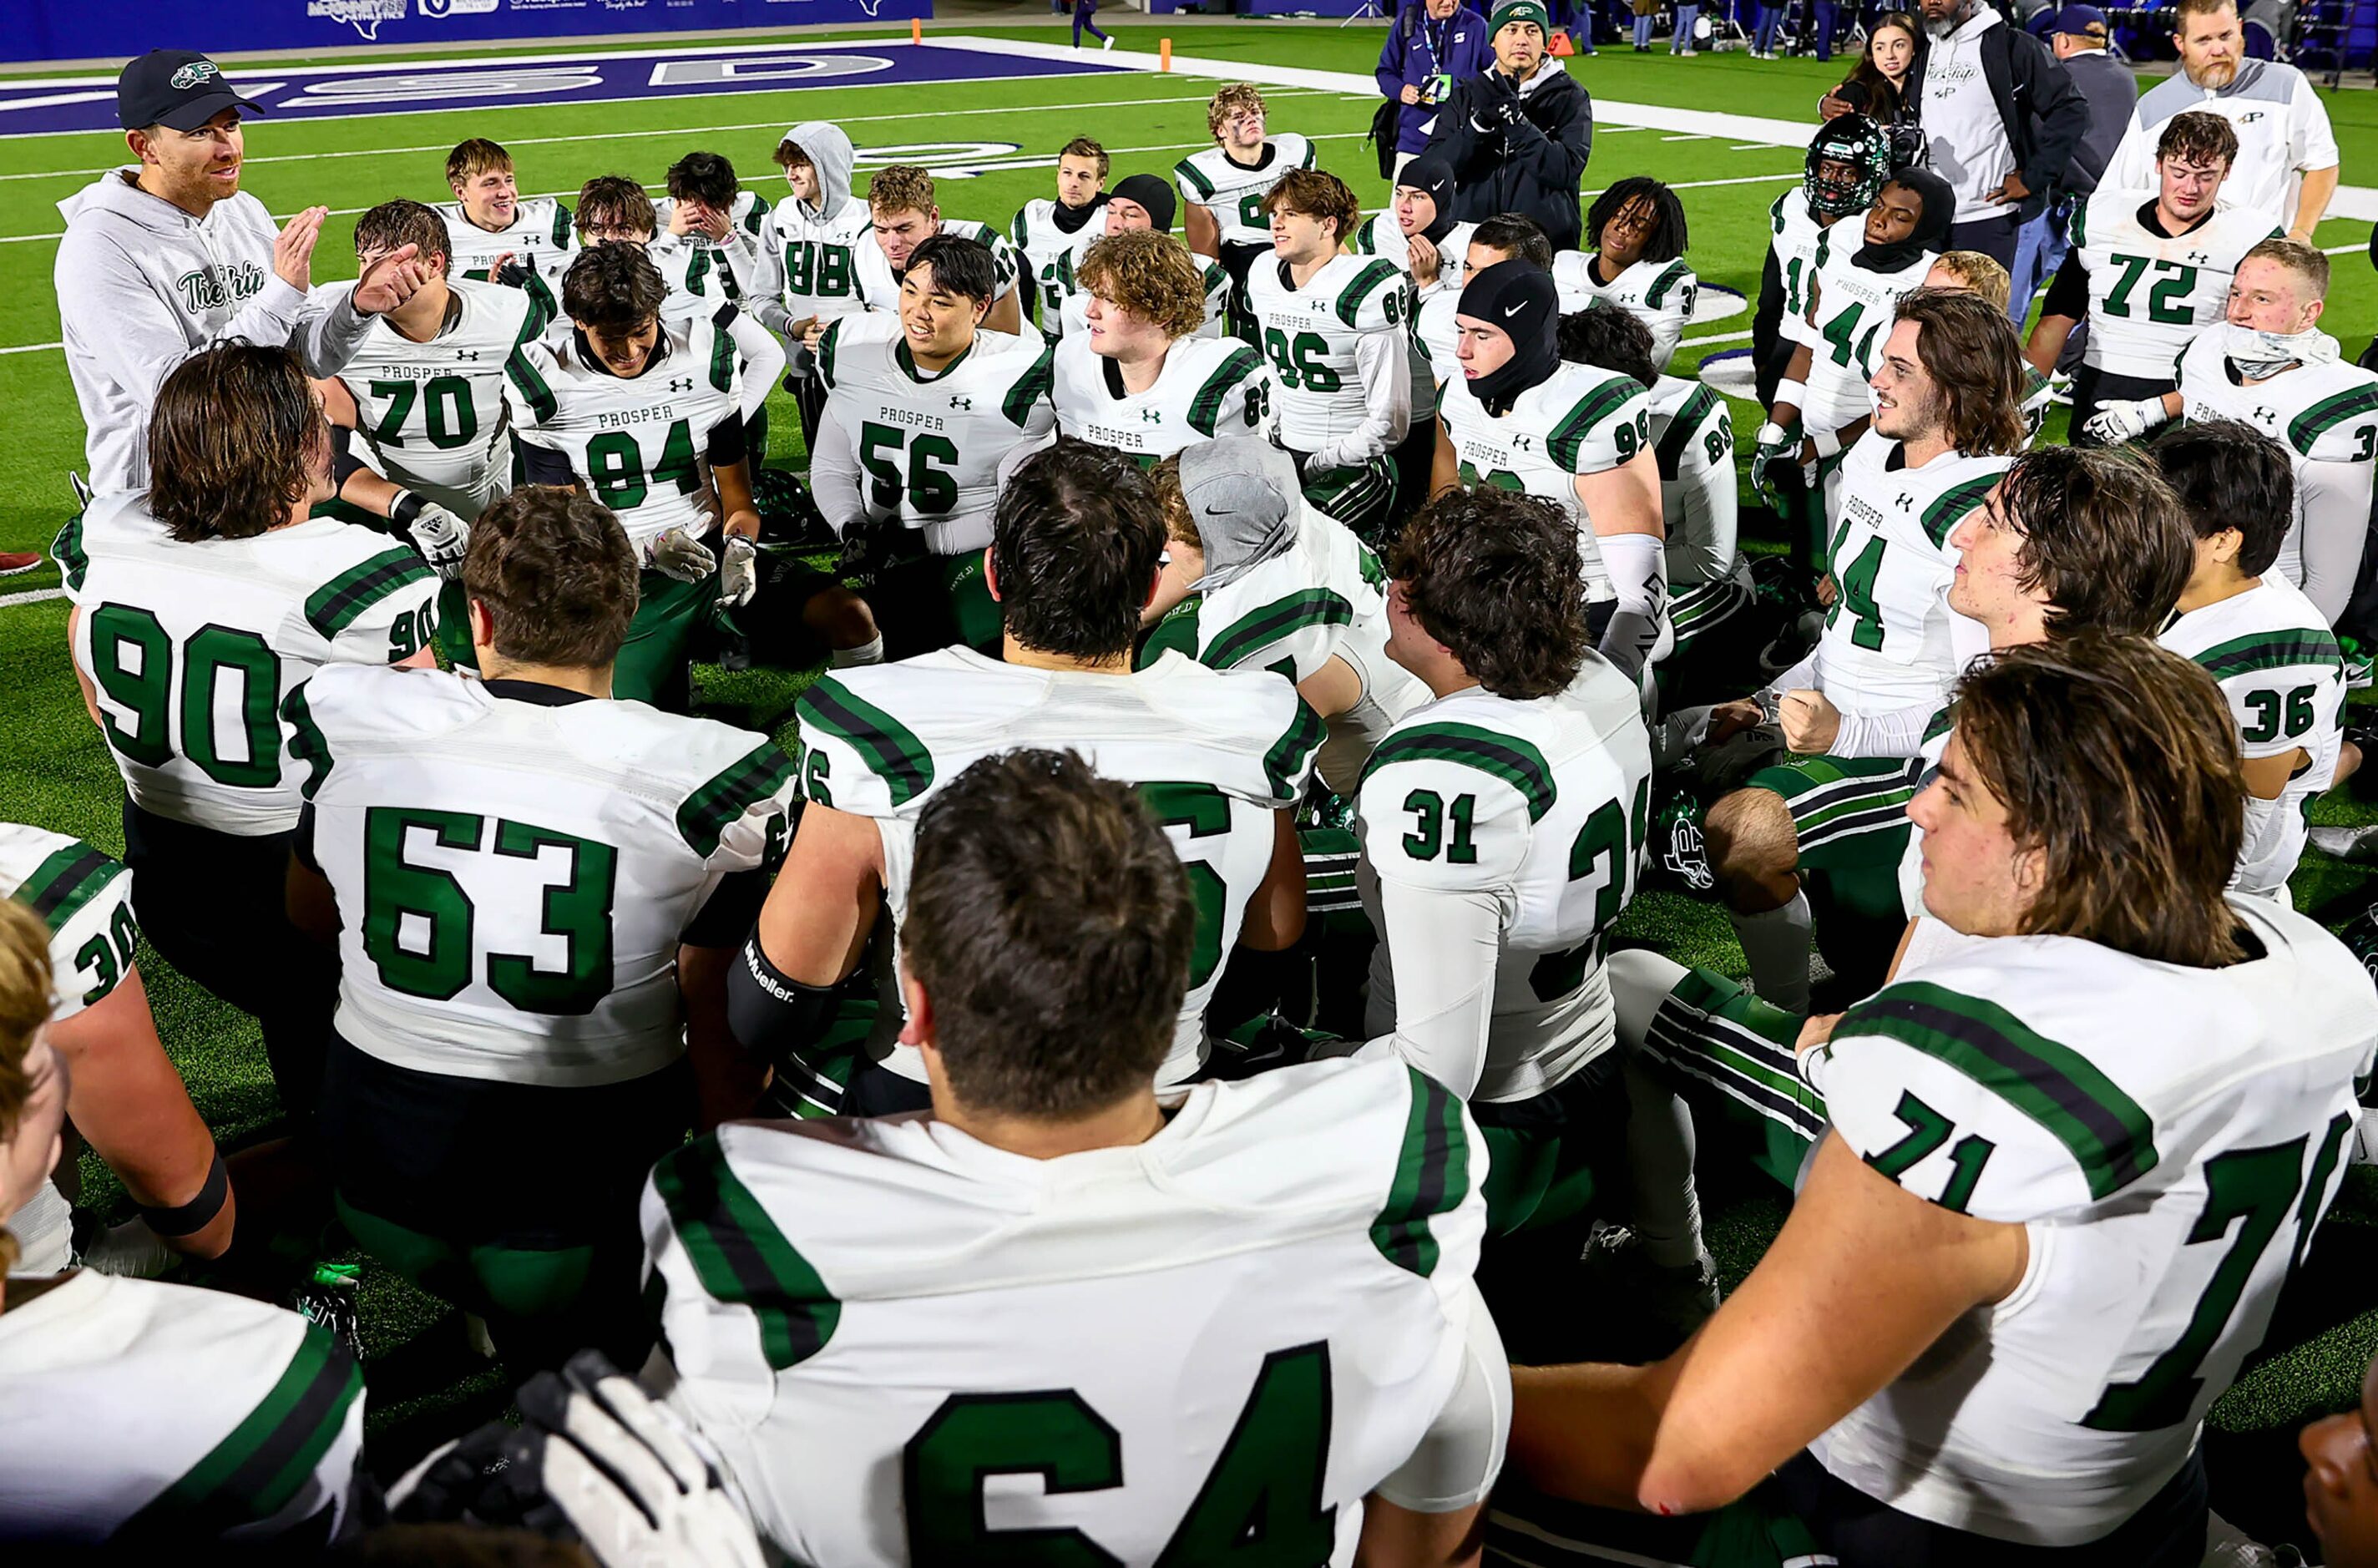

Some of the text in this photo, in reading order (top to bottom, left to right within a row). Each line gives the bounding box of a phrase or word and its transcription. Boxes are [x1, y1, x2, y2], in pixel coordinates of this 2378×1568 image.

[473, 252, 527, 266] PROER
[2102, 252, 2198, 326] 72
[176, 270, 225, 315] The
[1268, 312, 1311, 330] PROSPER
[1383, 284, 1408, 326] 86
[1835, 278, 1881, 306] PROSPER
[1823, 301, 1866, 368] 4
[382, 366, 453, 379] PROSPER
[368, 375, 478, 450] 70
[598, 405, 674, 429] PROSPER
[879, 407, 944, 431] PROSPER
[1087, 424, 1144, 448] PROSPER
[585, 417, 703, 511] 84
[859, 420, 959, 514] 56
[1462, 440, 1509, 468] PROSPER
[1845, 494, 1884, 529] PROSPER
[388, 594, 436, 664] 90
[90, 600, 283, 788] 90
[2241, 683, 2318, 743] 36
[1400, 788, 1478, 864] 31
[362, 806, 619, 1016] 63
[75, 900, 138, 1007] 30
[1862, 1087, 1997, 1217] 71
[902, 1338, 1339, 1568] 64
